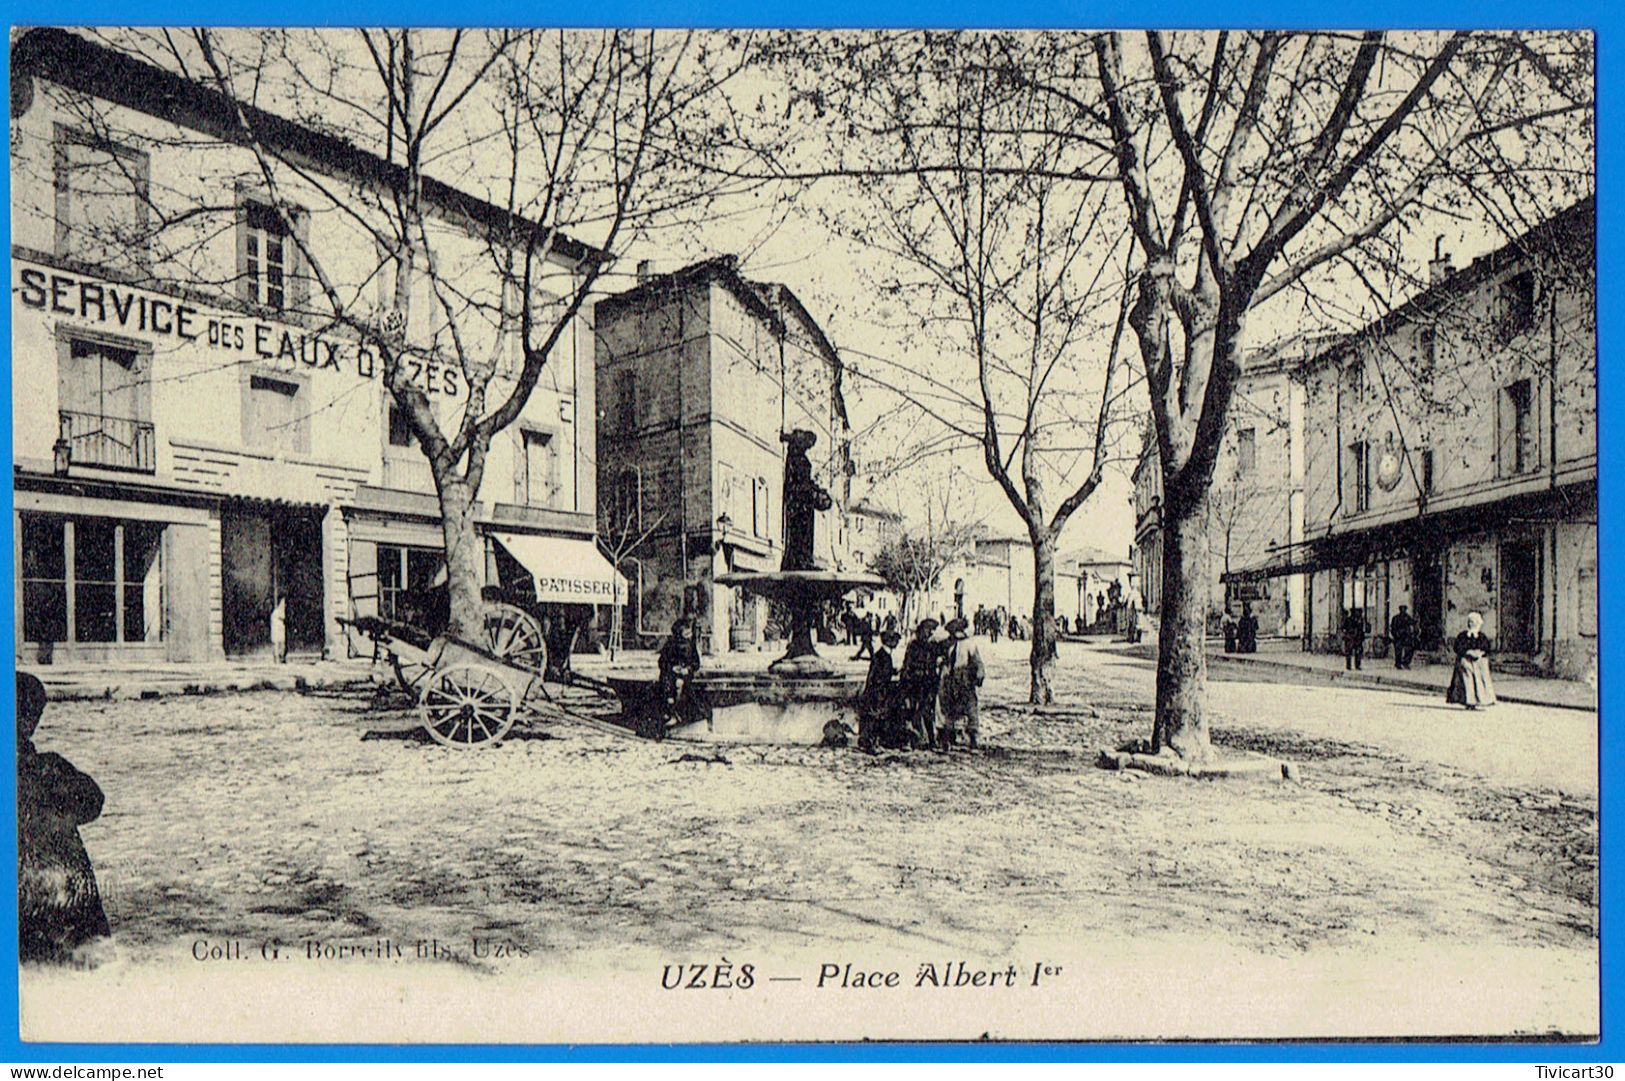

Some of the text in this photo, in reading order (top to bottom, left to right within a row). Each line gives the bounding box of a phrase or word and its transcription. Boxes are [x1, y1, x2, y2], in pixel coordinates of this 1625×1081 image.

[20, 268, 198, 341] SERVICE
[208, 321, 245, 351] DES
[254, 324, 342, 372] EAUX
[539, 577, 626, 597] PATISSERE
